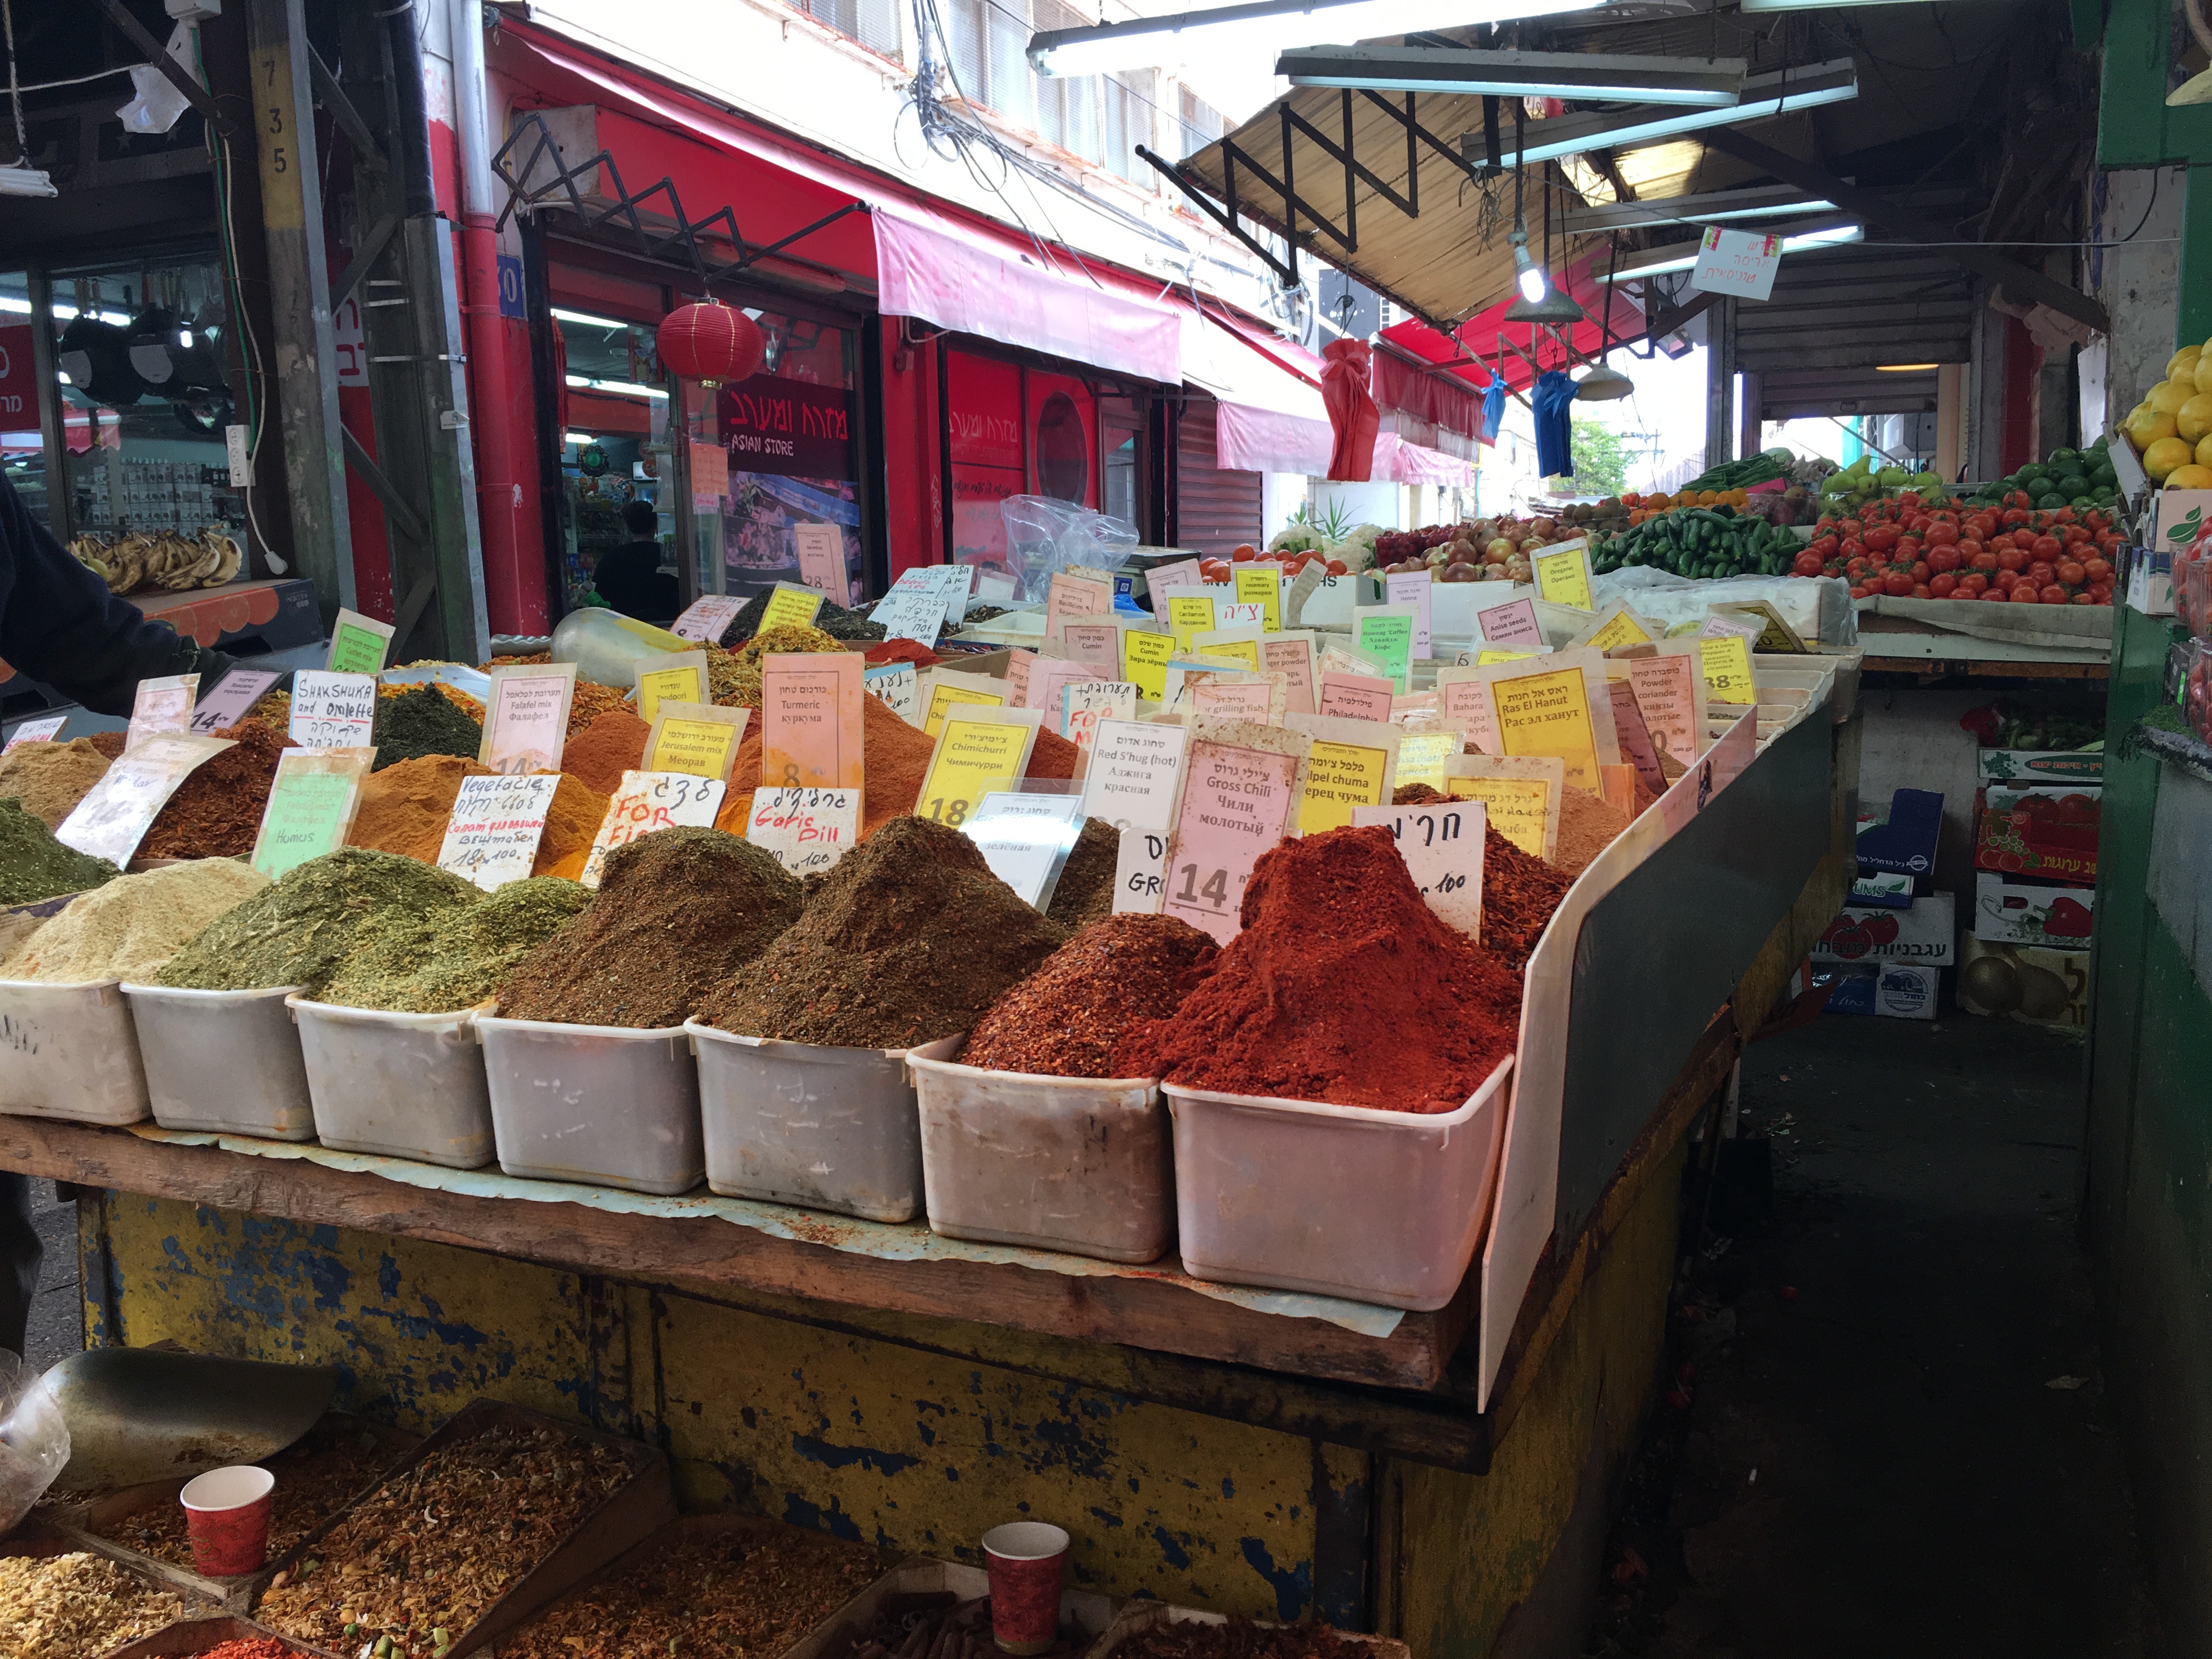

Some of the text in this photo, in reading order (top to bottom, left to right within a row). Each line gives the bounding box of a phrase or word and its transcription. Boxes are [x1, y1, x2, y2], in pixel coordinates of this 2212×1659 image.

[730, 390, 848, 441] מזרח ומערב
[732, 434, 794, 456] ASIAN STORE
[1550, 566, 1573, 575] Oregano
[1058, 600, 1084, 611] Basilicum
[1490, 617, 1527, 631] Anise seeds
[1513, 625, 1533, 635] аниса
[1140, 648, 1159, 656] Cumin
[1128, 655, 1146, 665] Зира
[1632, 667, 1680, 679] כוסברה טחון
[298, 677, 372, 699] SHAKSHUKA
[506, 690, 561, 699] תערובת לפלאפל
[779, 685, 827, 696] כורכום טחון
[1507, 686, 1568, 703] ראס אל חנות
[1638, 690, 1678, 699] coriander
[298, 701, 317, 714] and
[511, 700, 552, 709] Falafel mix
[781, 699, 820, 709] Turmeric
[1338, 696, 1373, 708] פילדלפיה
[1502, 696, 1568, 715] Ras El Hanut
[1643, 703, 1674, 711] кинзы
[1213, 704, 1245, 714] grilling
[190, 711, 218, 730] 14
[509, 712, 549, 721] Фалафел
[781, 714, 822, 724] куркума
[1504, 709, 1579, 728] Рас эл ханут
[667, 730, 725, 743] מעורב ירושלמי
[1116, 737, 1166, 748] סחוג אדום
[661, 741, 723, 755] Jerusalem mix
[952, 743, 1007, 754] Chimichurri
[668, 755, 706, 768] Меорав
[946, 757, 1003, 770] Чимичурри
[1098, 749, 1177, 768] Red S'hug (hot)
[1214, 763, 1238, 776] גרוס
[1340, 760, 1365, 772] פלפל
[783, 763, 800, 787] 8
[1108, 766, 1152, 780] Аджига
[1307, 770, 1369, 788] ilpel chuma
[1104, 783, 1150, 795] красная
[1207, 776, 1272, 797] Gross Chili
[1305, 787, 1369, 804] ерец чума
[1218, 794, 1254, 812] Чили
[616, 794, 676, 828] FOR
[930, 798, 969, 826] 18
[1199, 814, 1264, 837] молотый
[798, 827, 839, 843] Dill
[985, 842, 1032, 852] зелёная
[1177, 863, 1228, 908] 14
[1435, 873, 1465, 893] 100
[1872, 943, 1946, 957] עגבניות
